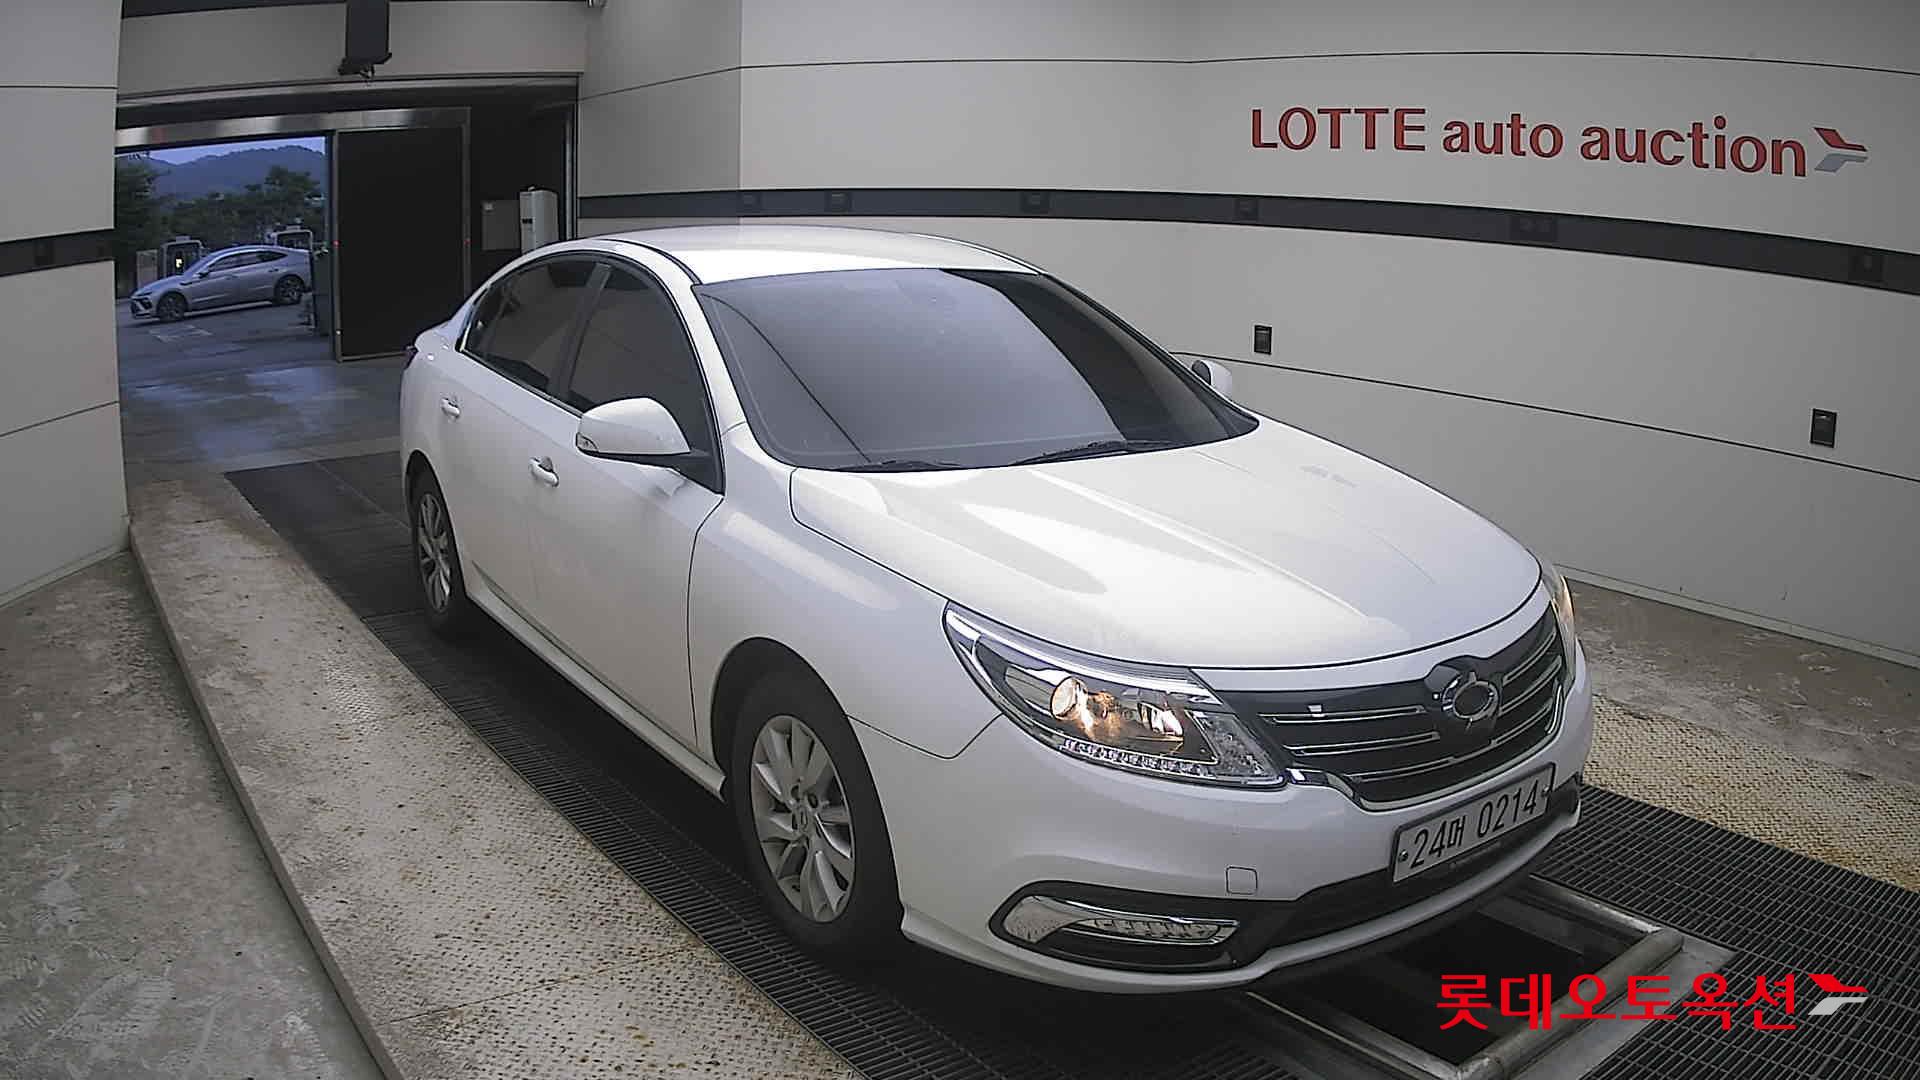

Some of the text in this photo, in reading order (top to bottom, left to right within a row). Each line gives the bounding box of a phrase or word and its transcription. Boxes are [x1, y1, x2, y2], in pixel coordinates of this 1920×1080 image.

[1251, 107, 1807, 177] LOTTE auto auction
[1410, 779, 1539, 869] 24머 0214
